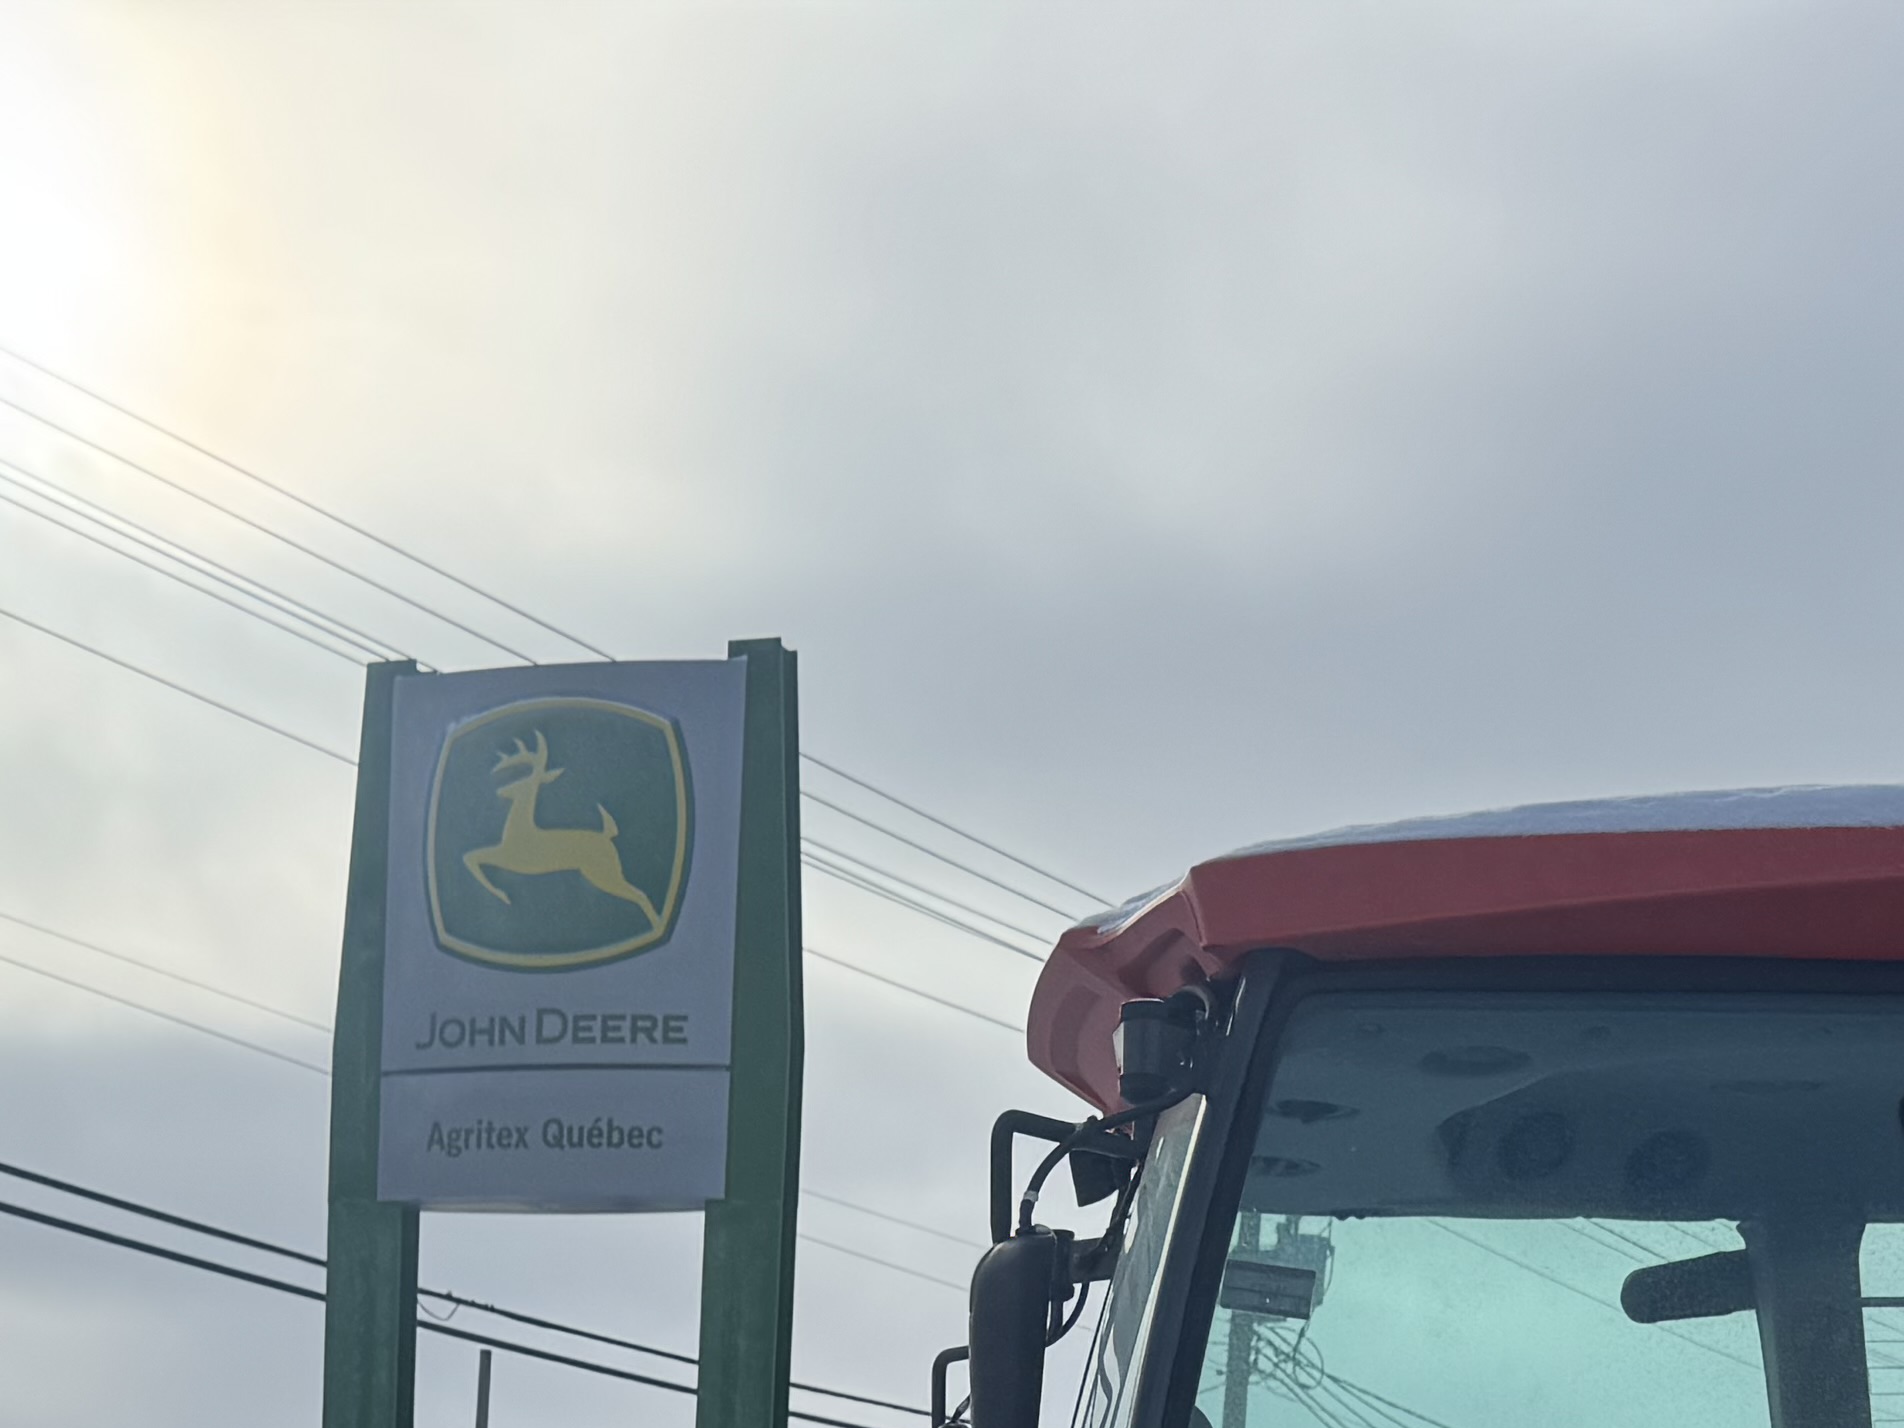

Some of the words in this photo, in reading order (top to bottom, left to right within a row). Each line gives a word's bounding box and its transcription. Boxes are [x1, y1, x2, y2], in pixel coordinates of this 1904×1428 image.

[415, 1010, 526, 1050] JOHN
[534, 1007, 690, 1046] DEERE
[427, 1119, 530, 1158] Agritex
[542, 1116, 664, 1150] Québec
